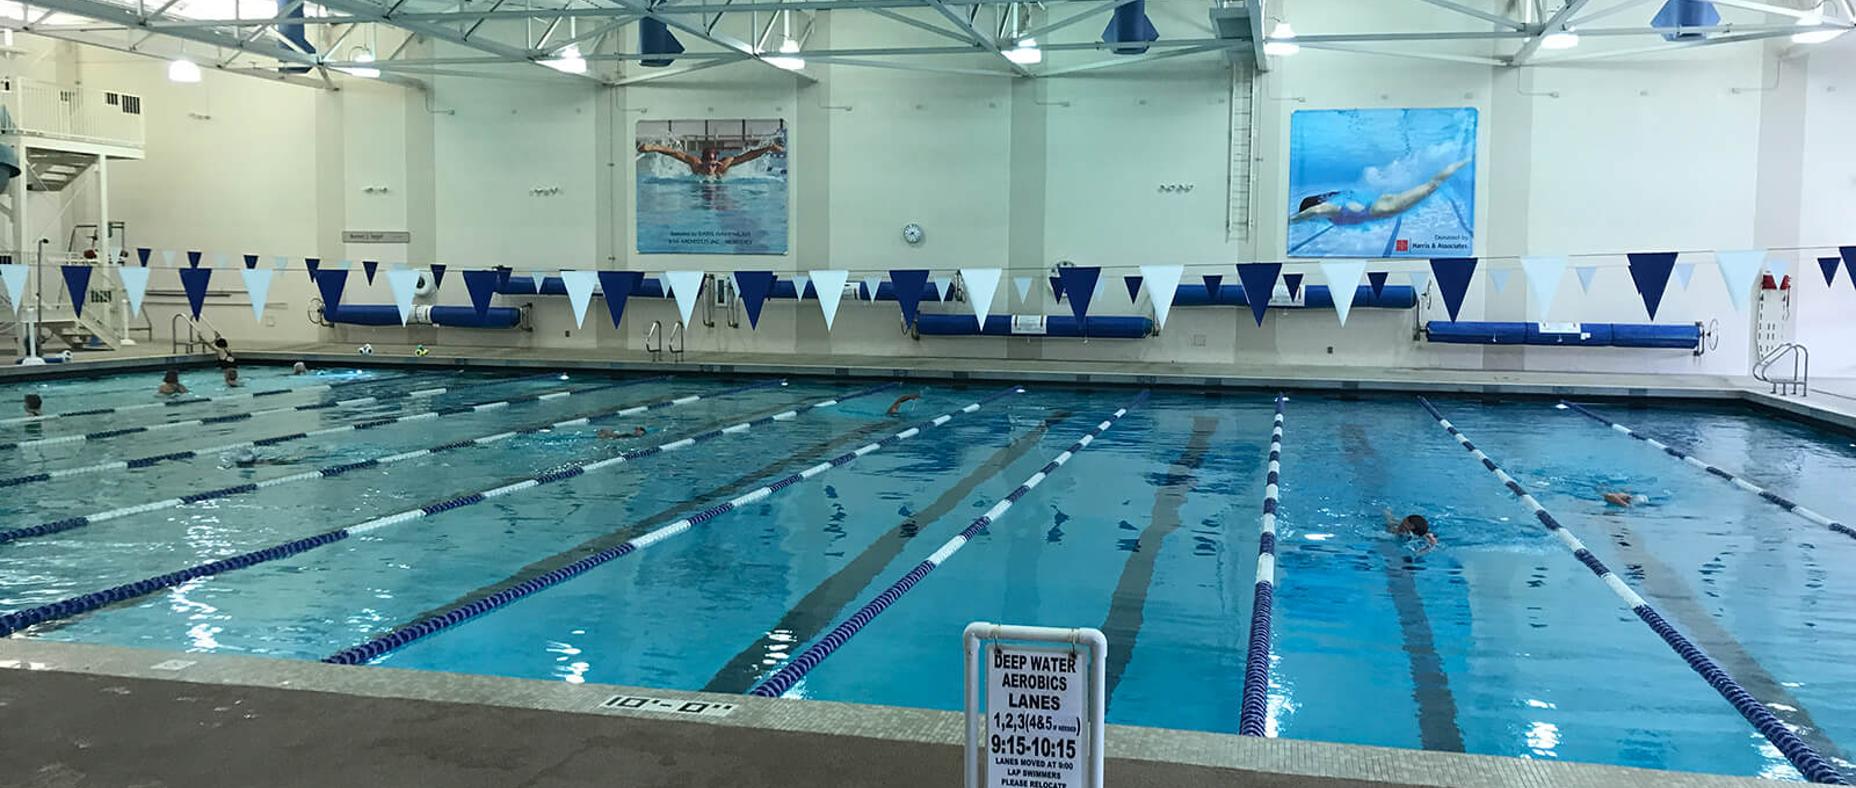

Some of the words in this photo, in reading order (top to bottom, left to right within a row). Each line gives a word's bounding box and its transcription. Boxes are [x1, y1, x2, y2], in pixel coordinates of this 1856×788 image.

[994, 654, 1027, 670] DEEP
[1031, 656, 1077, 673] WATER
[1002, 673, 1067, 691] AEROBICS
[1008, 693, 1061, 711] LANES
[991, 734, 1077, 759] 9:15-10:15
[995, 757, 1019, 766] LANES
[1020, 758, 1046, 767] MOVED
[1001, 778, 1028, 788] PLEASE
[1029, 780, 1067, 788] RELOCATE
[1007, 769, 1022, 777] LAP
[1023, 770, 1061, 780] SWIMMERS
